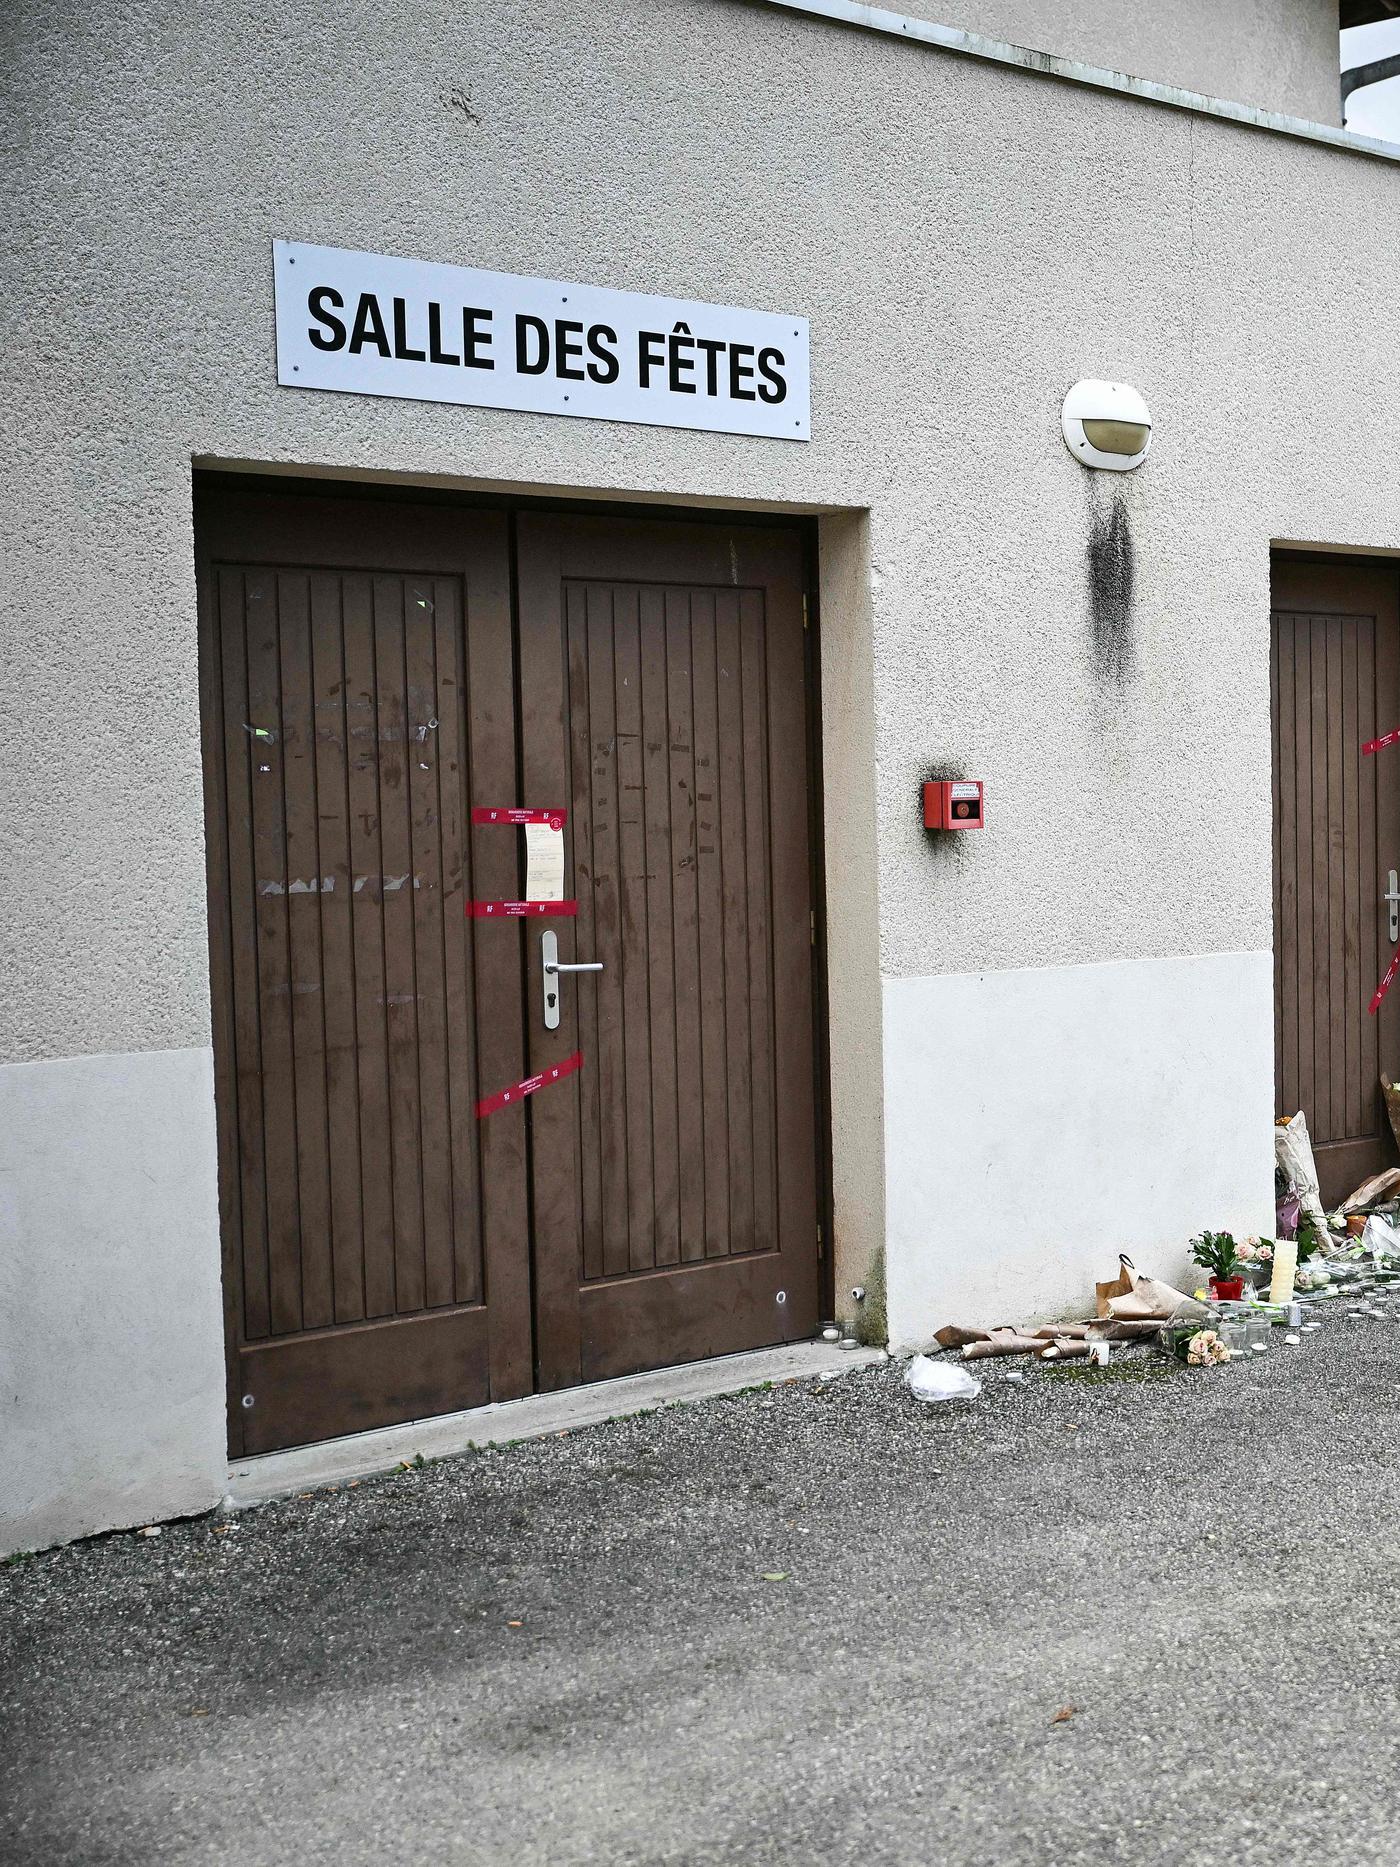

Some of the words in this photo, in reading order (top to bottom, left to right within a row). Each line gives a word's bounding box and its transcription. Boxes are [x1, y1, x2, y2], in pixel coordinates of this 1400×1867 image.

[308, 286, 495, 370] SALLE
[516, 314, 620, 384] DES
[639, 322, 787, 404] FÊTES
